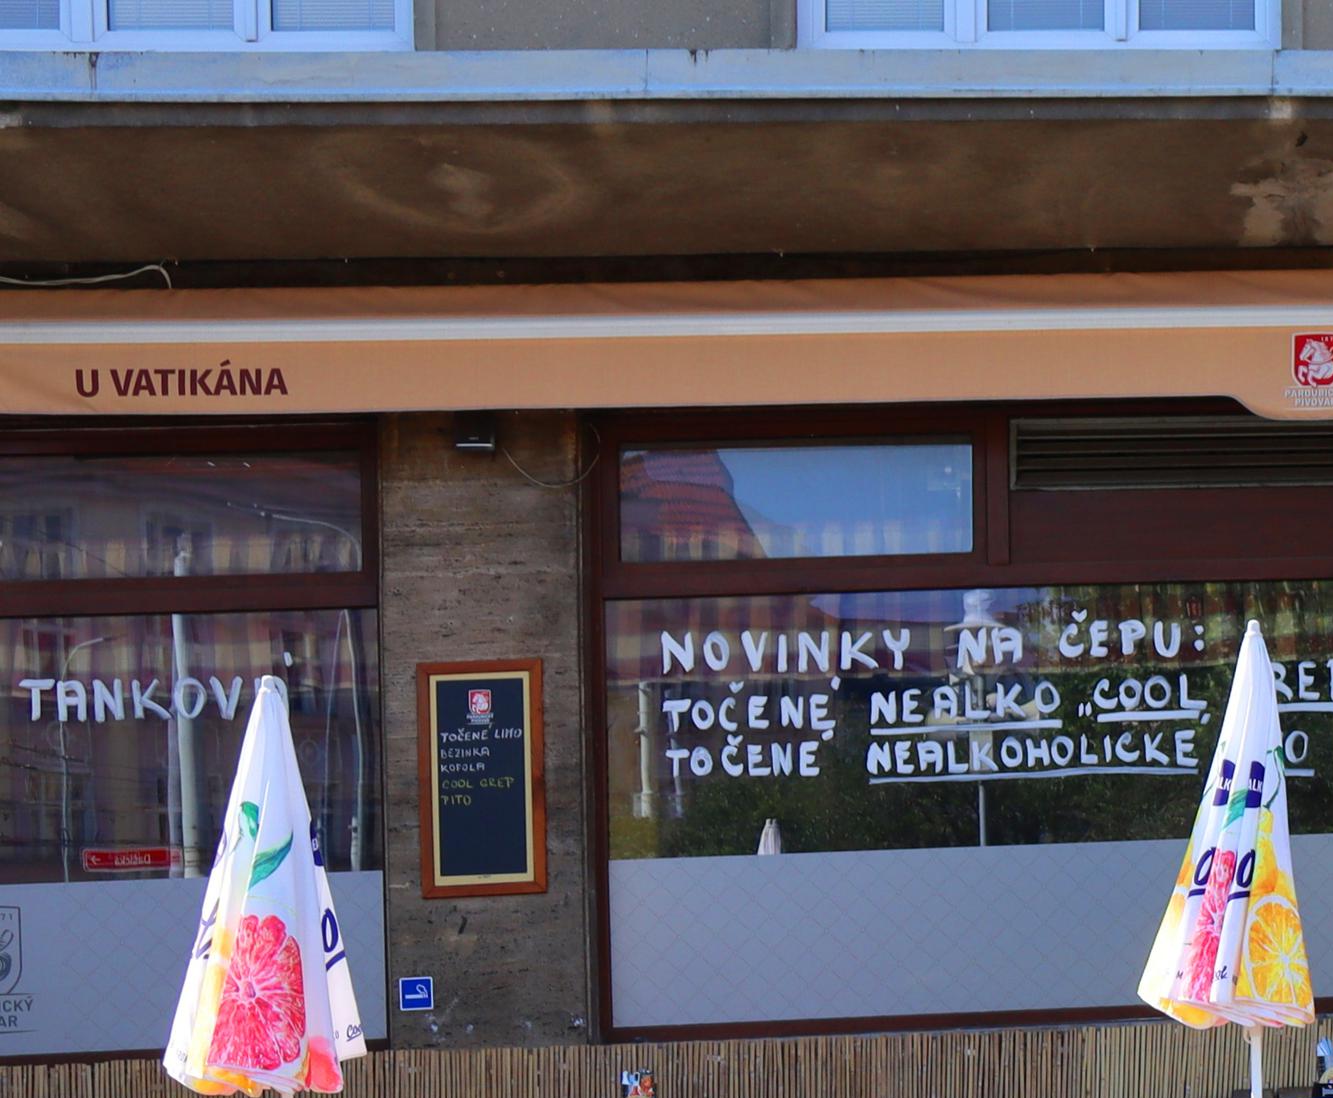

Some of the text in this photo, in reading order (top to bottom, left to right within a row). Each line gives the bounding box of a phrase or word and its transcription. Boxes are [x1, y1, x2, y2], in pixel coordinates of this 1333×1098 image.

[76, 359, 288, 397] U VATIKÁNA
[661, 608, 1205, 674] NOVINKY NA ČEPU:
[663, 676, 841, 732] TOČENÉ
[871, 680, 1061, 726] NEALKO
[440, 762, 486, 774] KOFOLA
[665, 729, 835, 777] TOČENÉ
[442, 779, 474, 790] COOL
